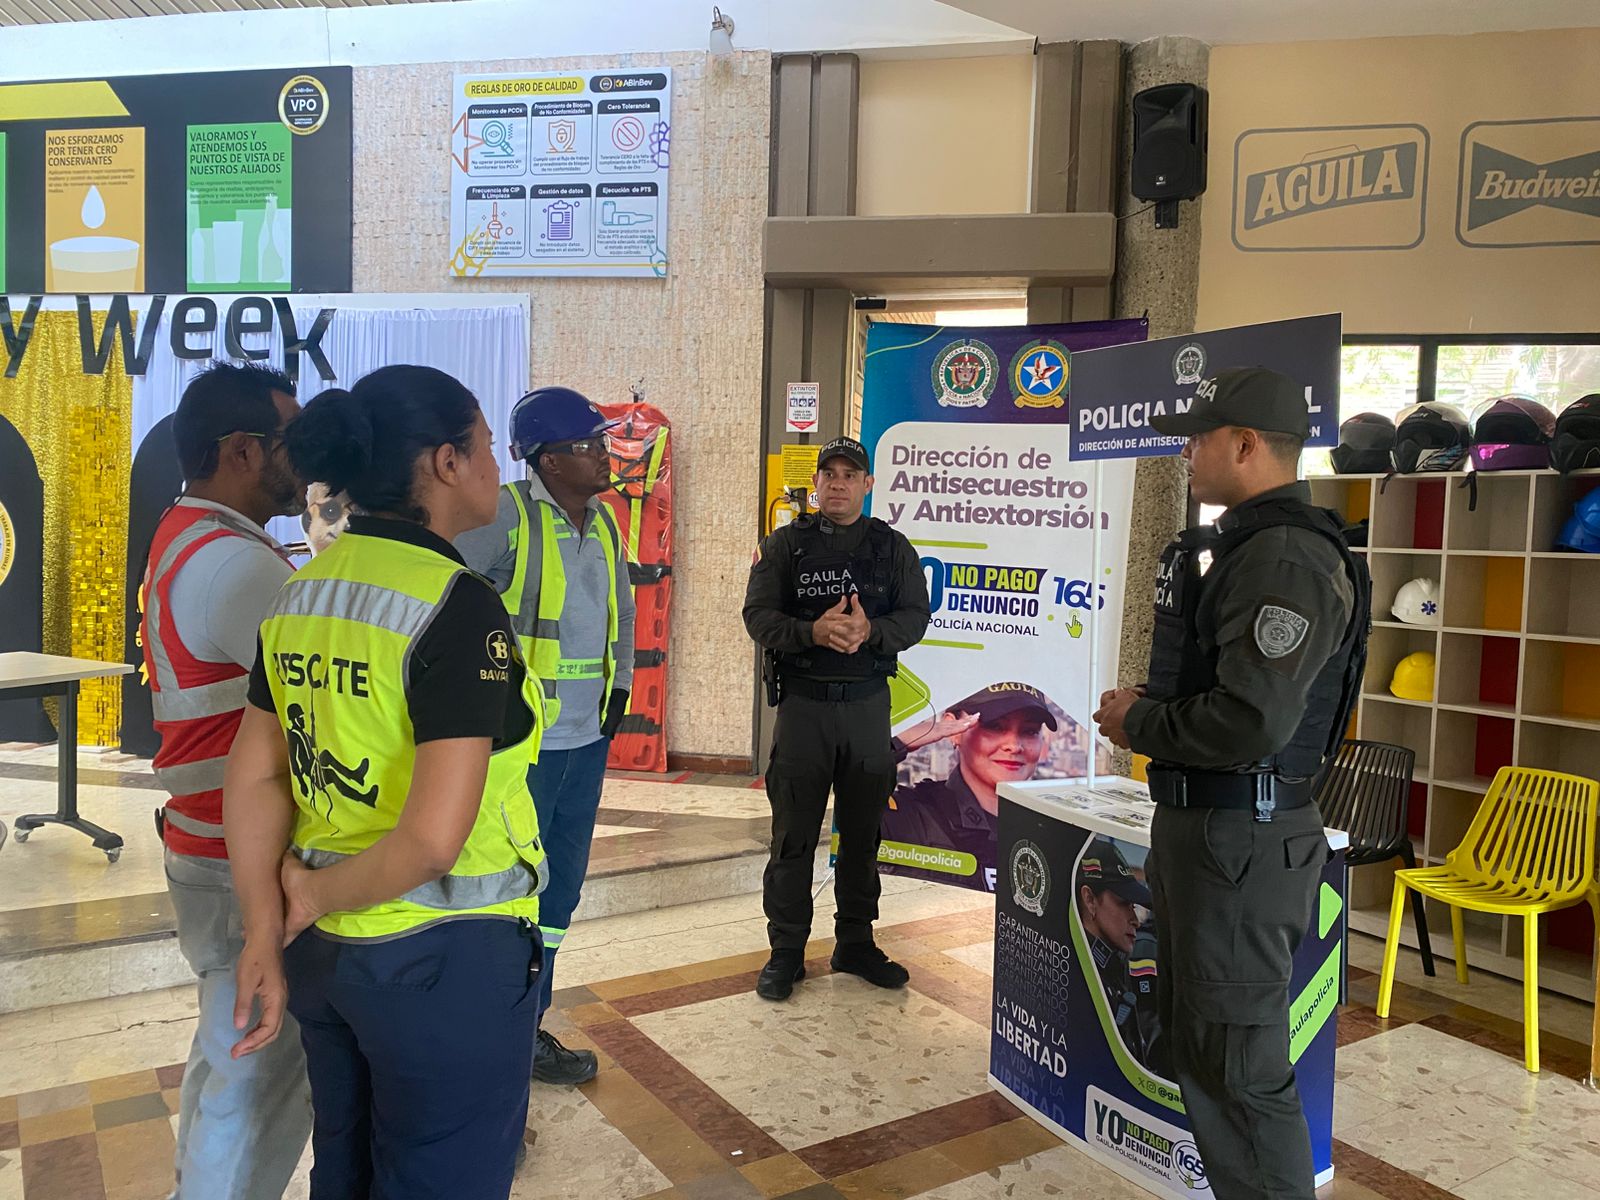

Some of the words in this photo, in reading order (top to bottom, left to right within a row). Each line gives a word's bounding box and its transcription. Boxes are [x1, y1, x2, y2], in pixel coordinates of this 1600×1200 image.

[471, 84, 500, 94] REGLAS
[502, 83, 512, 93] DE
[514, 82, 530, 92] ORO
[532, 82, 542, 91] DE
[544, 81, 577, 91] CALIDAD
[290, 98, 316, 112] VPO
[48, 136, 66, 145] NOS
[68, 134, 124, 144] ESFORZAMOS
[190, 130, 248, 142] VALORAMOS
[250, 130, 256, 140] Y
[190, 142, 247, 152] ATENDEMOS
[250, 142, 267, 151] LOS
[48, 147, 65, 156] POR
[68, 146, 94, 155] TENER
[96, 145, 118, 154] CERO
[48, 156, 112, 166] CONSERVANTES
[190, 154, 227, 164] PUNTOS
[230, 153, 242, 162] DE
[244, 153, 270, 162] VISTA
[273, 152, 285, 161] DE
[190, 164, 238, 175] NUESTROS
[240, 164, 280, 174] ALIADOS
[1253, 149, 1404, 222] AGUILA
[76, 294, 337, 381] Week
[1079, 400, 1167, 432] POLICIA
[892, 444, 1008, 468] Dirección
[1018, 448, 1052, 470] de
[1079, 438, 1122, 452] DIRECCIÓN
[1125, 439, 1137, 448] DE
[890, 470, 1088, 498] Antisecuestro
[888, 502, 905, 525] y
[913, 500, 1108, 530] Antiextorsión
[798, 580, 858, 598] POLICÍA
[800, 569, 852, 584] GAULA
[951, 565, 978, 587] NO
[984, 568, 1038, 592] PAGO
[947, 592, 1039, 618] DENUNCIO
[928, 616, 973, 631] POLICÍA
[976, 622, 1039, 636] NACIONAL
[988, 682, 1038, 699] GAULA
[878, 843, 962, 868] @gaulapolicia
[998, 912, 1070, 959] GARANTIZANDO
[998, 925, 1069, 973] GARANTIZANDO
[1289, 976, 1334, 1040] aulapolicia
[996, 992, 1008, 1013] LA
[1011, 1002, 1037, 1032] VIDA
[1041, 1020, 1048, 1038] Y
[1052, 1028, 1067, 1051] LA
[996, 1012, 1068, 1078] LIBERTAD
[1094, 1099, 1124, 1146] YO
[1126, 1121, 1140, 1138] NO
[1143, 1130, 1169, 1153] PAGO
[1177, 1149, 1205, 1176] 165
[1096, 1135, 1114, 1150] GAULA
[1115, 1147, 1138, 1164] POLICÍA
[1139, 1160, 1171, 1180] NACIONAL
[1125, 1136, 1171, 1169] DENUNCIO
